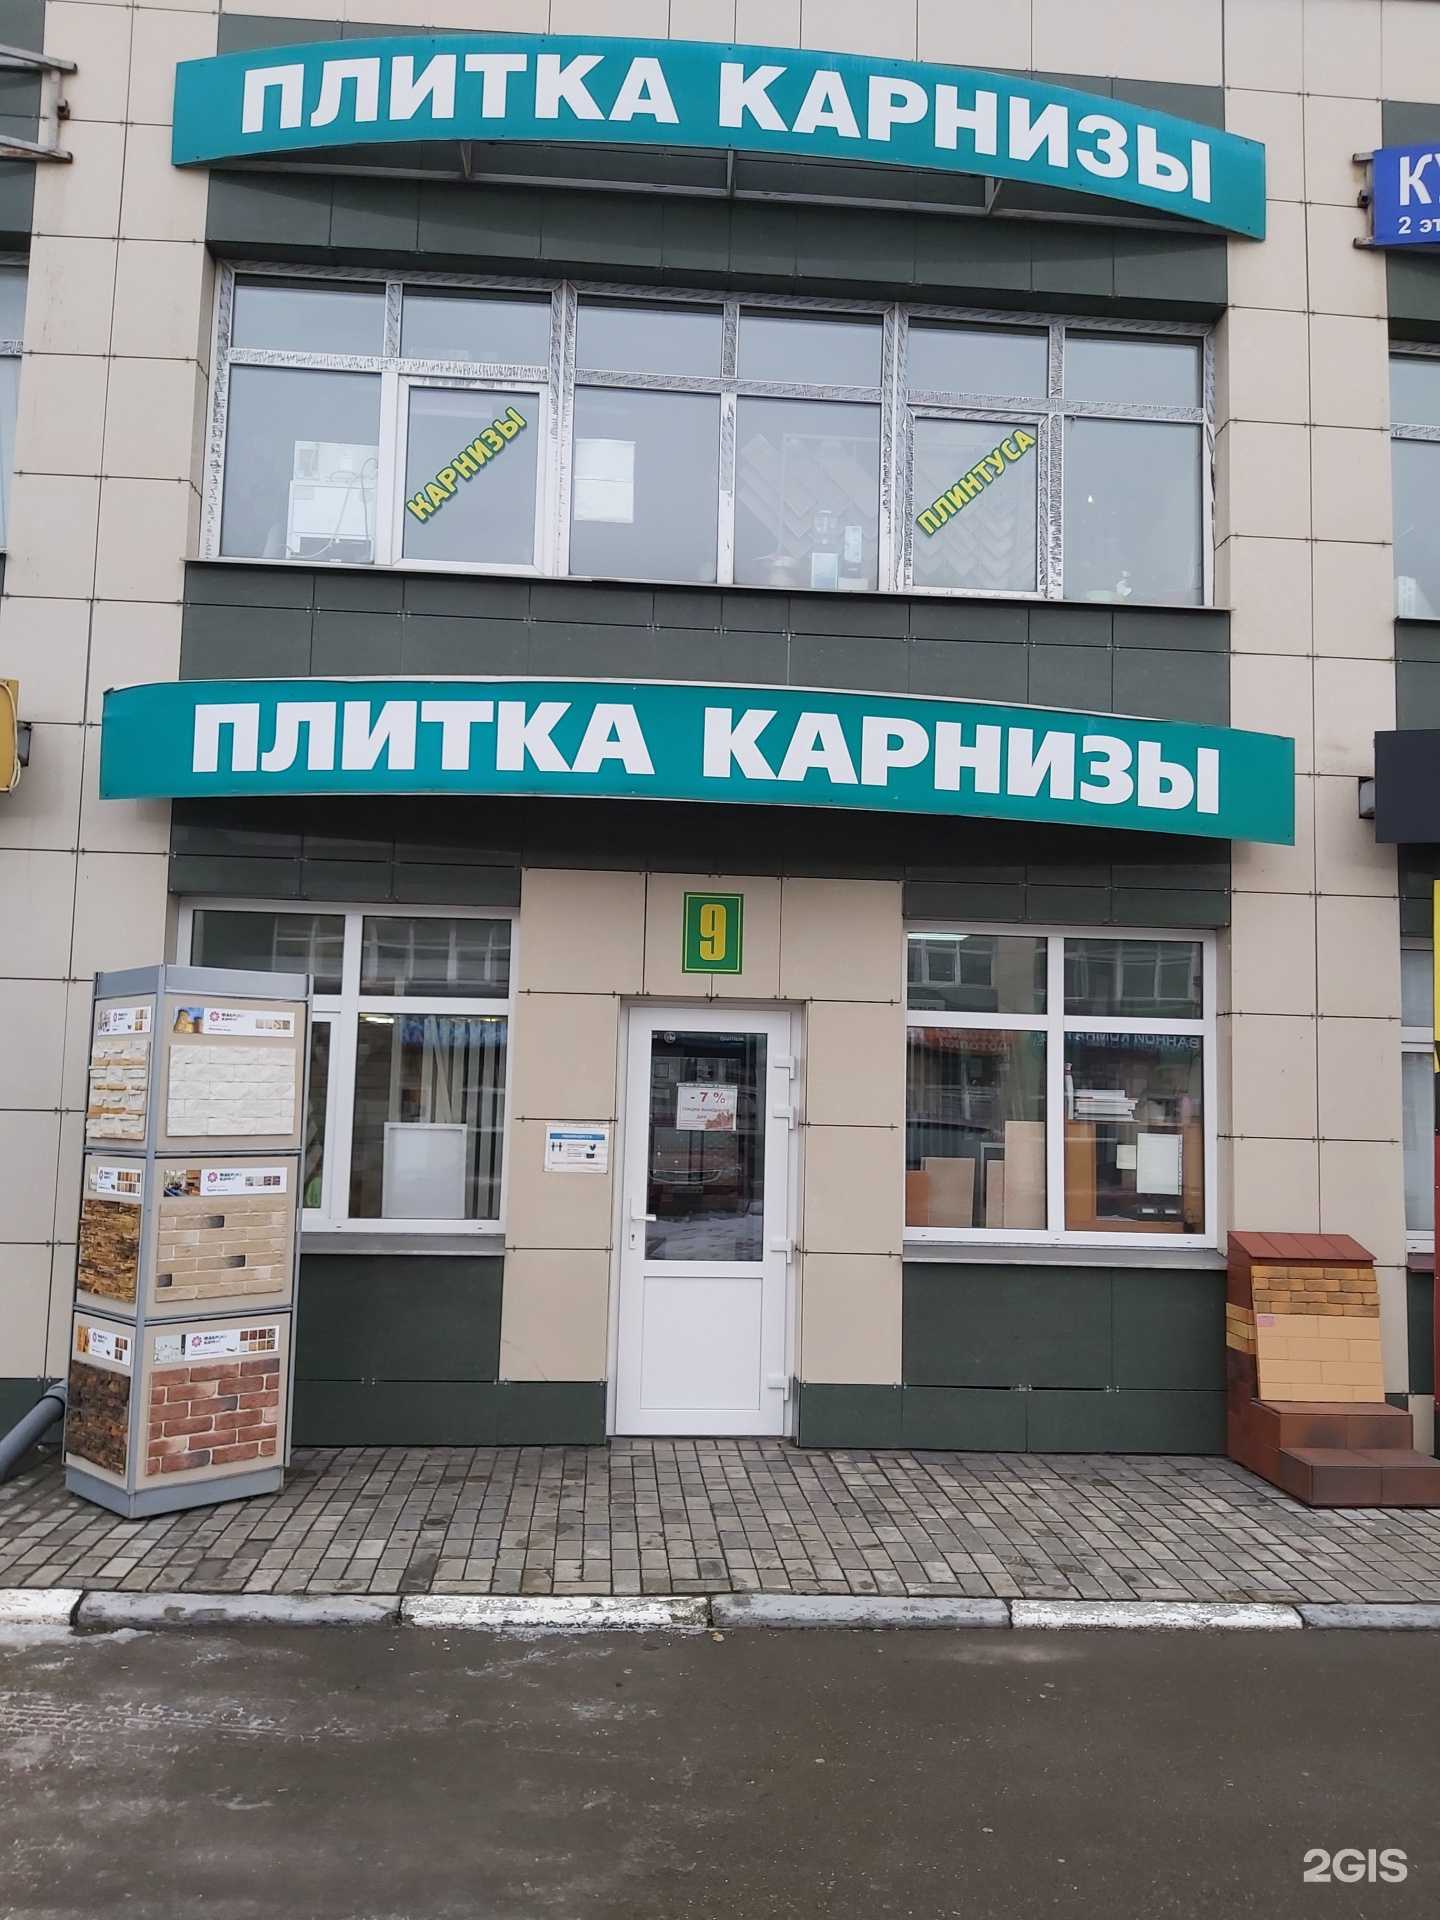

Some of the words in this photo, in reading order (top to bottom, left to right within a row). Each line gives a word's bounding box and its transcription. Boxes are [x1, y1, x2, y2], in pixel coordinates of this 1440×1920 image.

[241, 53, 680, 134] ПЛИТКА
[717, 62, 1212, 204] КАРНИЗЫ
[1398, 216, 1411, 234] 2
[407, 408, 526, 522] КАРНИЗЫ
[916, 430, 1037, 534] ПЛИНТУСА
[192, 700, 655, 775] ПЛИТКА
[703, 706, 1220, 814] КАРНИЗЫ
[700, 903, 727, 961] 9
[700, 1091, 709, 1103] 7
[713, 1092, 726, 1104] %
